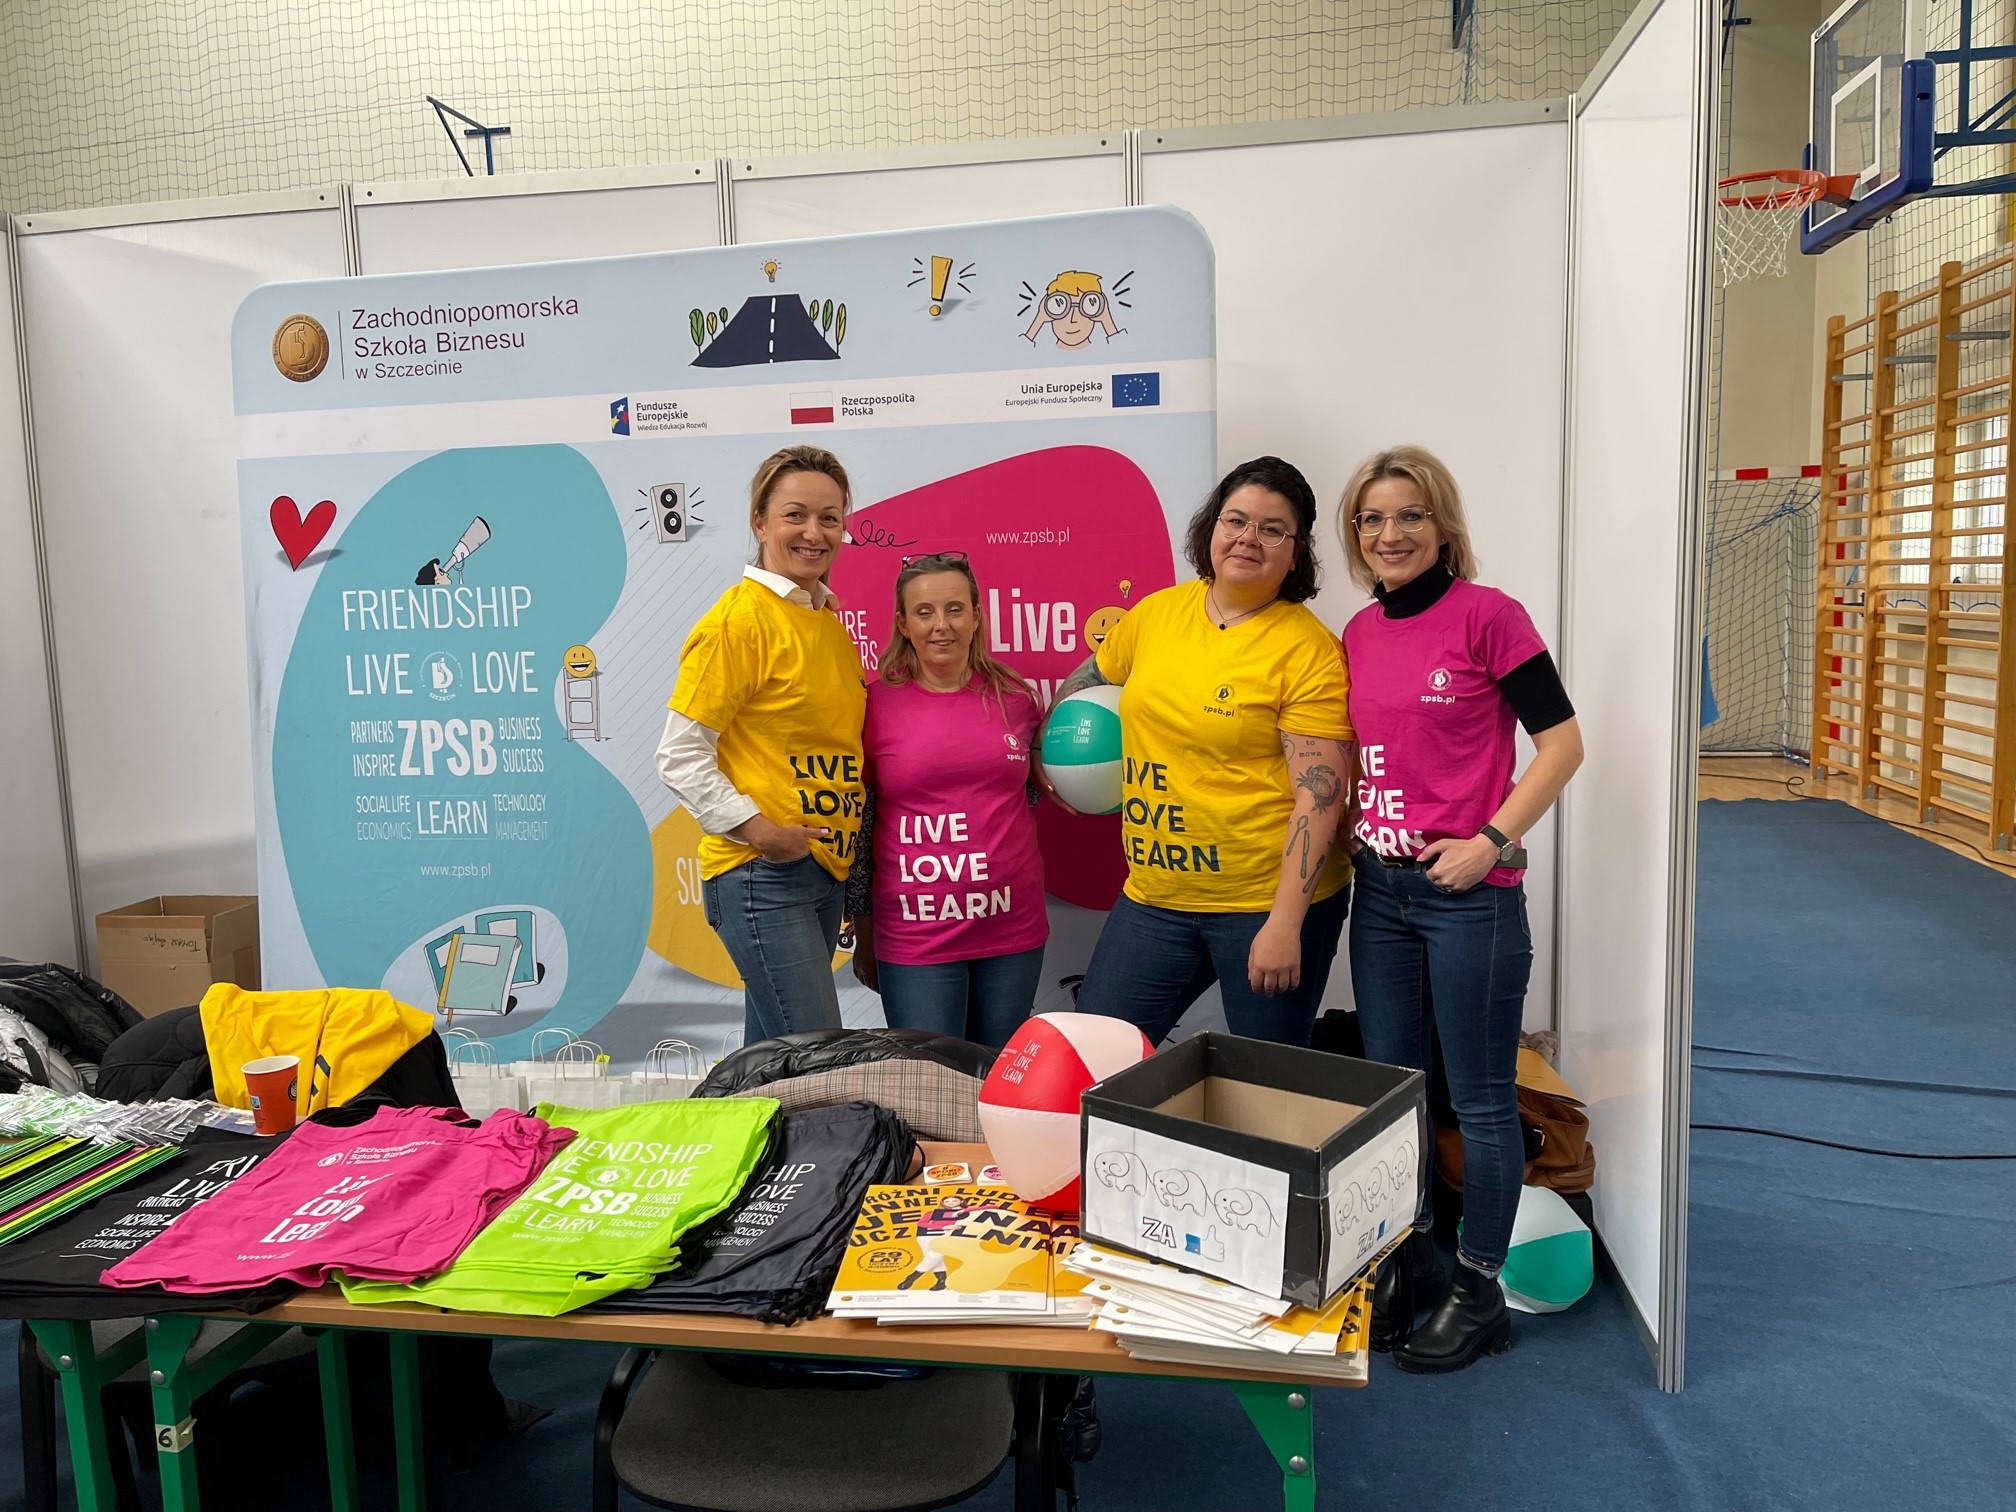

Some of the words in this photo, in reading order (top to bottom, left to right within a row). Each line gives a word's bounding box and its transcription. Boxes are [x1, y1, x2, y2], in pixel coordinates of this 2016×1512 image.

[352, 296, 579, 330] Zachodniopomorska
[354, 334, 427, 357] Szkoła
[436, 331, 525, 352] Biznesu
[355, 367, 368, 379] w
[375, 359, 463, 379] Szczecinie
[1021, 383, 1044, 395] Unia
[1046, 381, 1103, 396] Europejska
[636, 402, 678, 411] Fundusze
[841, 392, 915, 407] Rzeczpospolita
[1005, 397, 1039, 407] Europejski
[1041, 396, 1068, 405] Fundusz
[636, 410, 689, 422] Europejskie
[842, 407, 874, 416] Polska
[637, 423, 659, 431] Wiedza
[660, 422, 685, 431] Edukacja
[686, 422, 708, 430] Rozwój
[986, 526, 1070, 547] www.zpsb.pl
[342, 585, 532, 631] FRIENDSHIP
[834, 610, 868, 640] IRE
[988, 587, 1076, 652] Live
[346, 653, 413, 695] LIVE
[471, 651, 538, 694] LOVE
[1421, 694, 1456, 705] zpsb.pl
[1203, 705, 1235, 718] zpsb.pl
[350, 720, 394, 744] PARTNERS
[498, 717, 542, 740] BUSINESS
[397, 718, 497, 776] ZPSB
[353, 754, 397, 777] INSPIRE
[502, 748, 544, 773] SUCCESS
[790, 755, 859, 782] LIVE
[1361, 744, 1386, 777] VE
[1122, 757, 1168, 792] IVE
[356, 795, 391, 814] SOCIAL
[392, 795, 411, 813] LIFE
[492, 793, 546, 811] TECHNOLOGY
[798, 790, 862, 818] LOVE
[416, 800, 488, 835] LEARN
[1124, 797, 1186, 832] OVE
[357, 821, 412, 841] ECONOMICS
[495, 821, 549, 841] MANAGEMENT
[900, 813, 969, 844] LIVE
[421, 863, 491, 878] www.zpsb.pl
[899, 852, 989, 883] LOVE
[898, 886, 1011, 922] LEARN
[1023, 1039, 1041, 1057] LIVE
[1013, 1052, 1033, 1071] LOVE
[1001, 1064, 1024, 1085] LEARN
[632, 1166, 699, 1188] LOVE
[762, 1163, 817, 1182] HIP
[532, 1176, 638, 1215] ZPSB
[641, 1192, 684, 1205] BUSINESS
[750, 1183, 804, 1200] OVE
[865, 1187, 940, 1204] RÓŻNI
[955, 1187, 1022, 1201] LUD
[630, 1205, 674, 1218] SUCCESS
[861, 1196, 938, 1217] INNE
[114, 1213, 172, 1226] INSPIRE
[524, 1208, 602, 1233] LEARN
[734, 1212, 778, 1226] SUCCESS
[855, 1209, 1052, 1236] JEDNA
[849, 1226, 1052, 1255] UCZELNIA
[1141, 1216, 1177, 1249] ZA
[75, 1239, 142, 1249] ECONOMICS
[158, 1427, 173, 1448] 6
